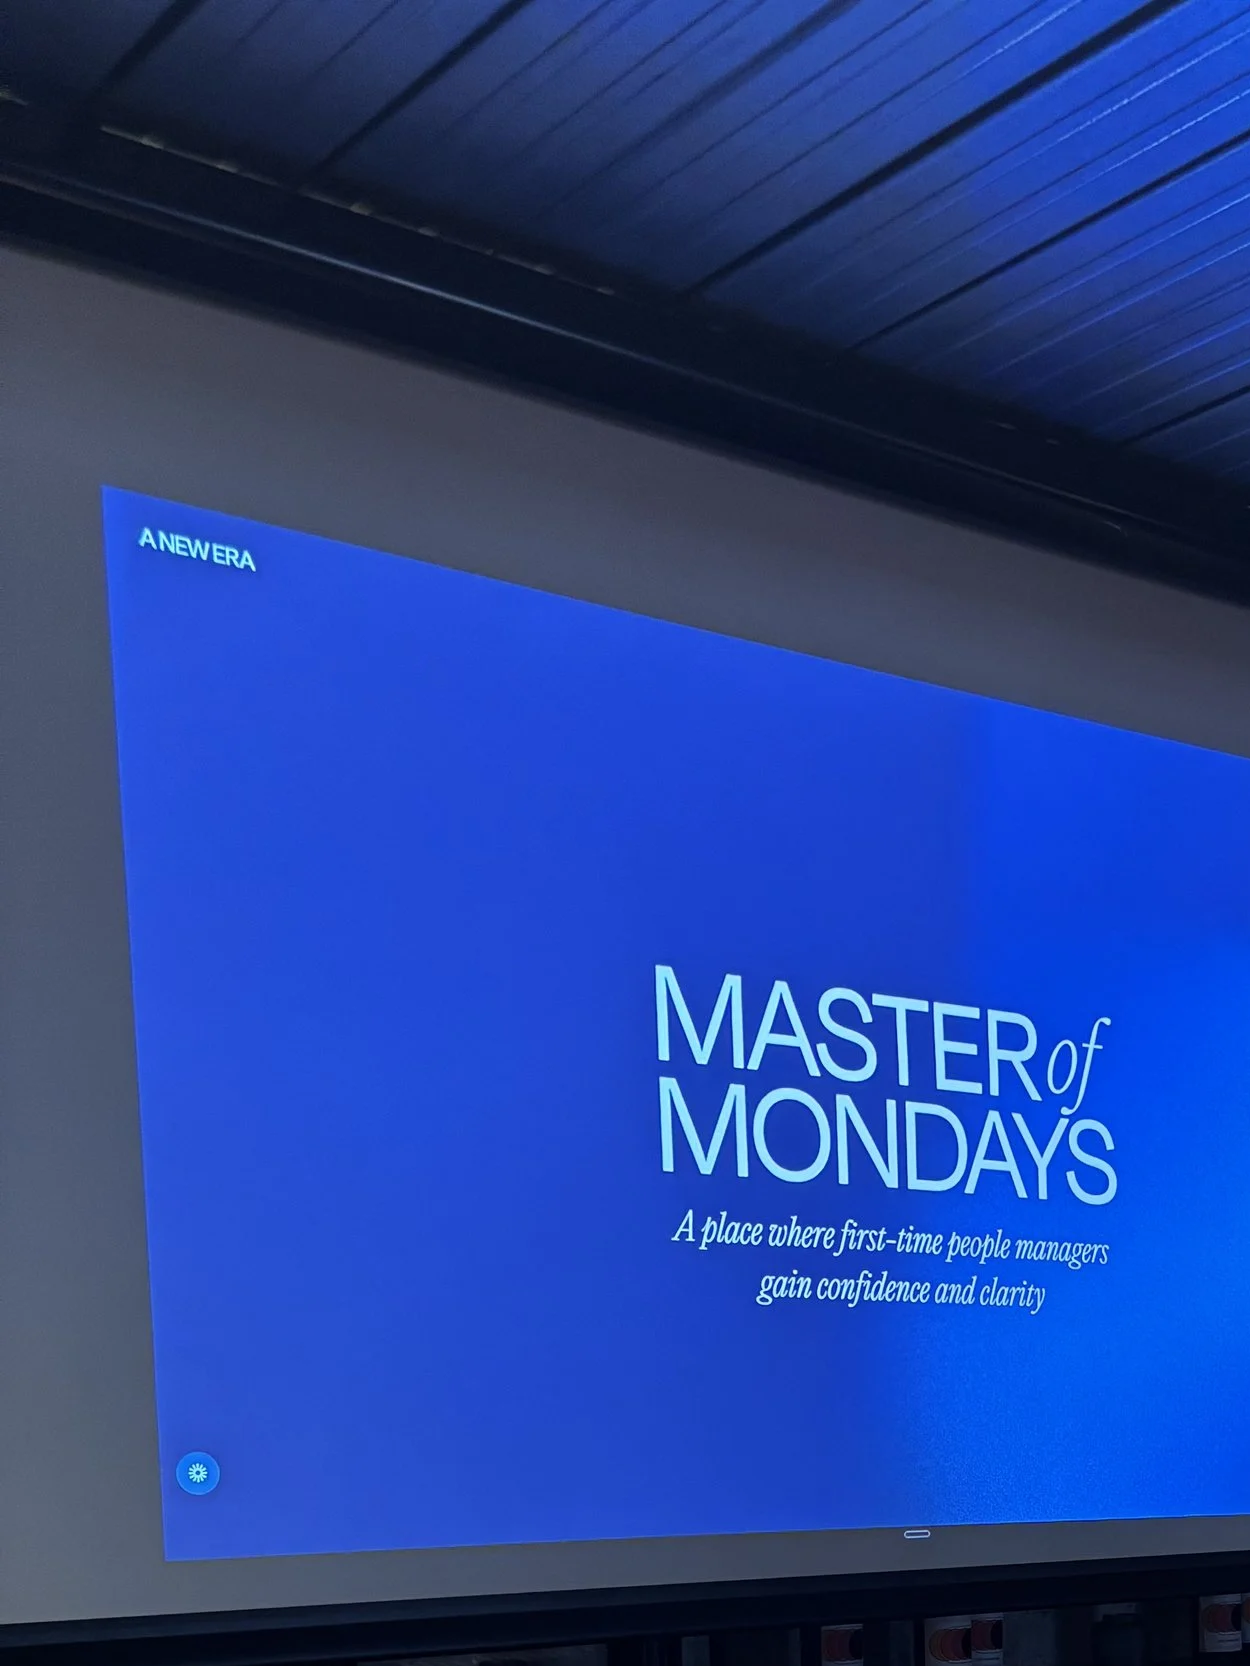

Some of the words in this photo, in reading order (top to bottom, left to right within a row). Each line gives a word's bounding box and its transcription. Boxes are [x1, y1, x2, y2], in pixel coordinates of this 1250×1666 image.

[138, 527, 157, 550] A
[158, 530, 210, 560] NEW
[212, 542, 256, 572] ERA
[655, 965, 1042, 1101] MASTER
[1046, 1017, 1111, 1116] of
[659, 1076, 1118, 1205] MONDAYS
[671, 1209, 695, 1242] A
[699, 1211, 763, 1250] place
[768, 1215, 836, 1250] where
[832, 1219, 943, 1257] first-time
[945, 1229, 1011, 1265] people
[1015, 1237, 1110, 1270] managers
[756, 1269, 812, 1306] gain
[816, 1270, 931, 1308] confidence
[934, 1275, 978, 1305] and
[979, 1276, 1046, 1315] clarity
